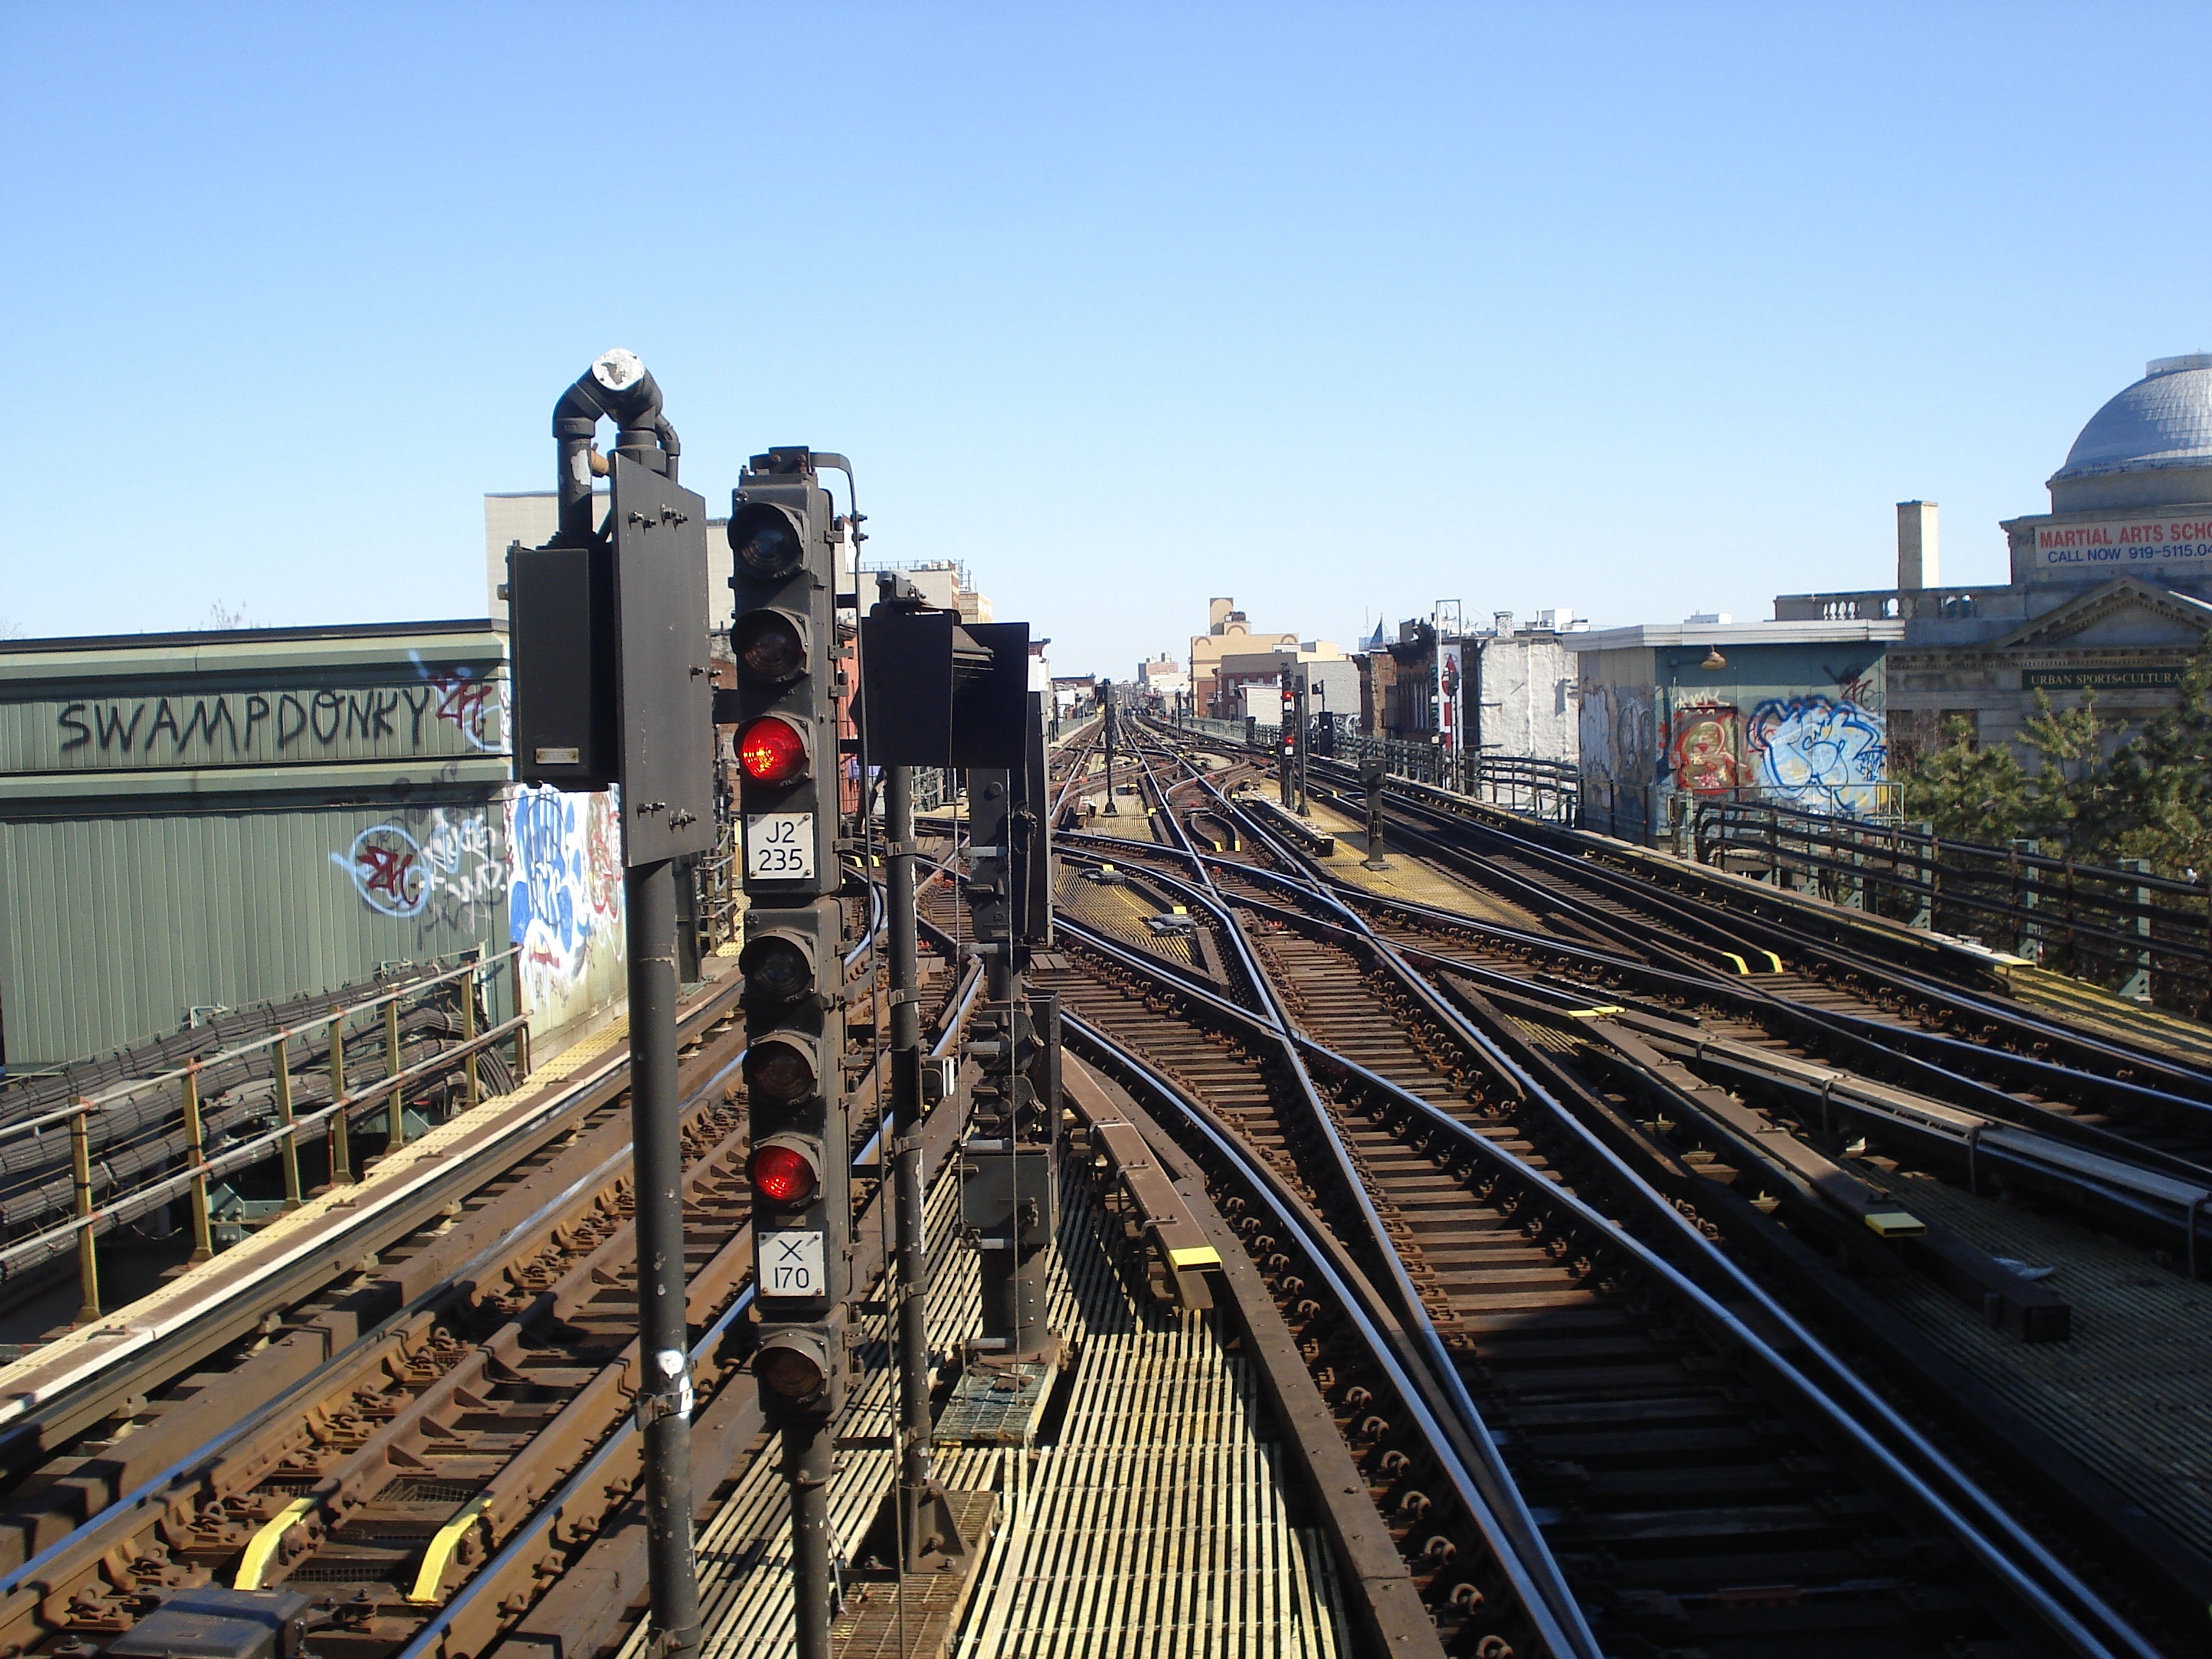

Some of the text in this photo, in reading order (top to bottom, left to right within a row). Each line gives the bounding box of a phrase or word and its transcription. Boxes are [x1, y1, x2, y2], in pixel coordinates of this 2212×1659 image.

[2040, 528, 2113, 549] MARTIAL
[2119, 525, 2164, 543] ARTS
[2048, 550, 2084, 563] CALL
[2088, 548, 2121, 561] NOW
[2031, 675, 2072, 685] URBAN
[58, 688, 430, 754] SWAMPDONKY
[765, 822, 795, 843] J2
[758, 848, 803, 871] 235
[778, 1239, 804, 1262] X
[775, 1267, 809, 1289] 170
